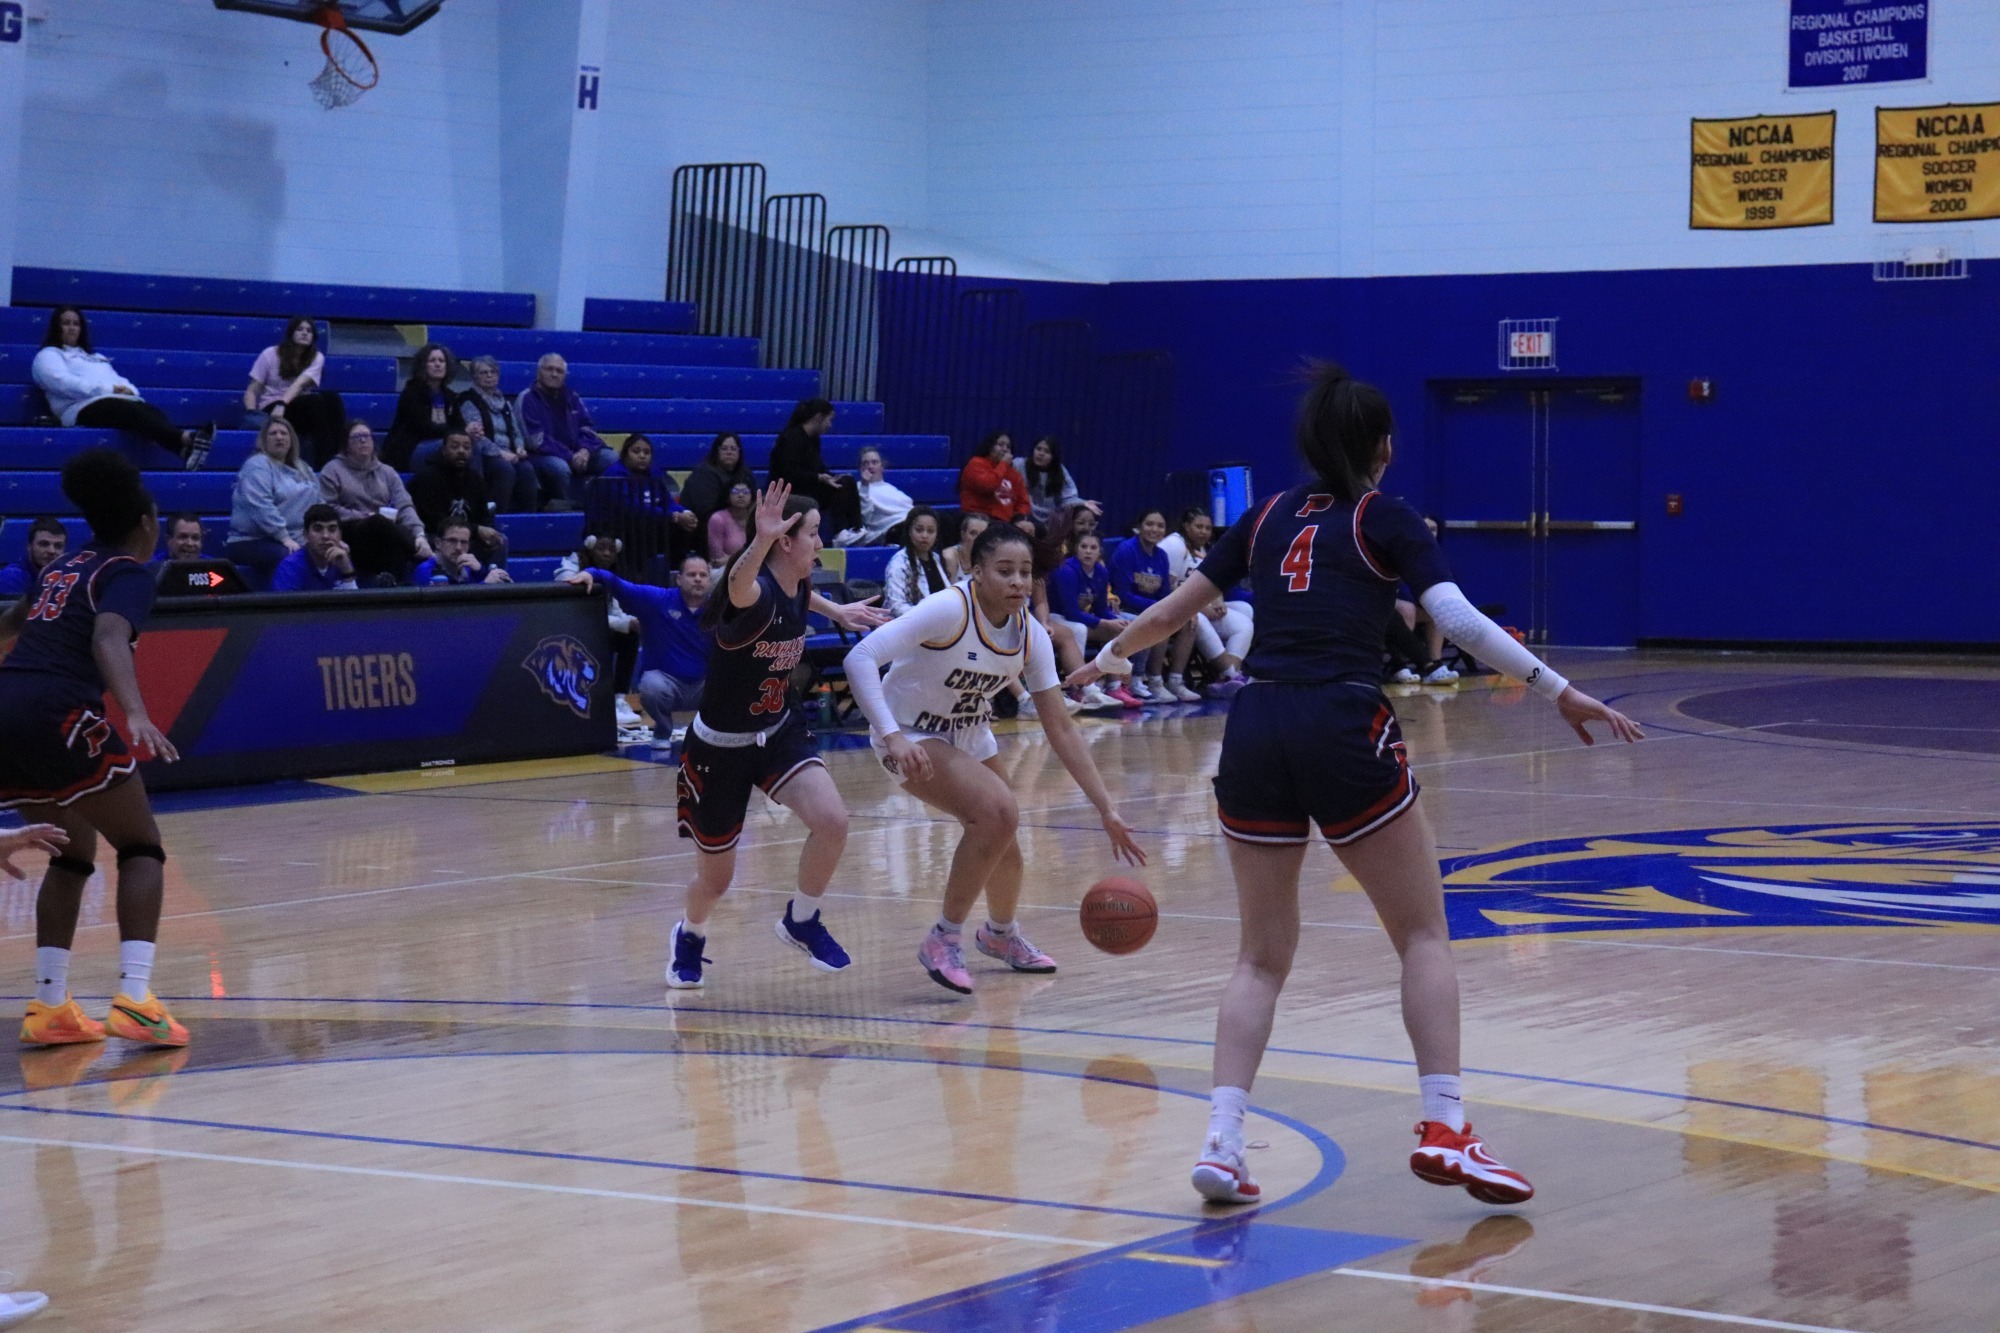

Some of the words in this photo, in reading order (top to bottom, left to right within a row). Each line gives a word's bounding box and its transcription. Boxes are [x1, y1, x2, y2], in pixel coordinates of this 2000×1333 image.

[0, 1, 23, 43] G
[1791, 11, 1851, 30] REGIONAL
[1853, 4, 1925, 26] CHAMPIONS
[1818, 26, 1895, 47] BASKETBALL
[1804, 47, 1855, 67] DIVISION
[1863, 43, 1908, 60] WOMEN
[1842, 64, 1869, 81] 2007
[579, 75, 599, 110] H
[1728, 124, 1793, 147] NCCAA
[1916, 113, 1985, 138] NCCAA
[1693, 152, 1753, 167] REGIONAL
[1760, 146, 1831, 163] CHAMPIONS
[1878, 143, 1941, 158] REGIONAL
[1733, 168, 1788, 184] SOCCER
[1922, 159, 1977, 176] SOCCER
[1738, 187, 1783, 203] WOMEN
[1925, 178, 1972, 194] WOMEN
[1745, 206, 1776, 220] 1999
[1929, 198, 1967, 213] 2000
[1518, 333, 1543, 354] EXIT
[1295, 493, 1335, 517] P
[1280, 524, 1319, 592] 4
[188, 572, 209, 586] POSS
[27, 570, 80, 621] 33
[317, 652, 417, 711] TIGERS
[82, 719, 111, 758] P
